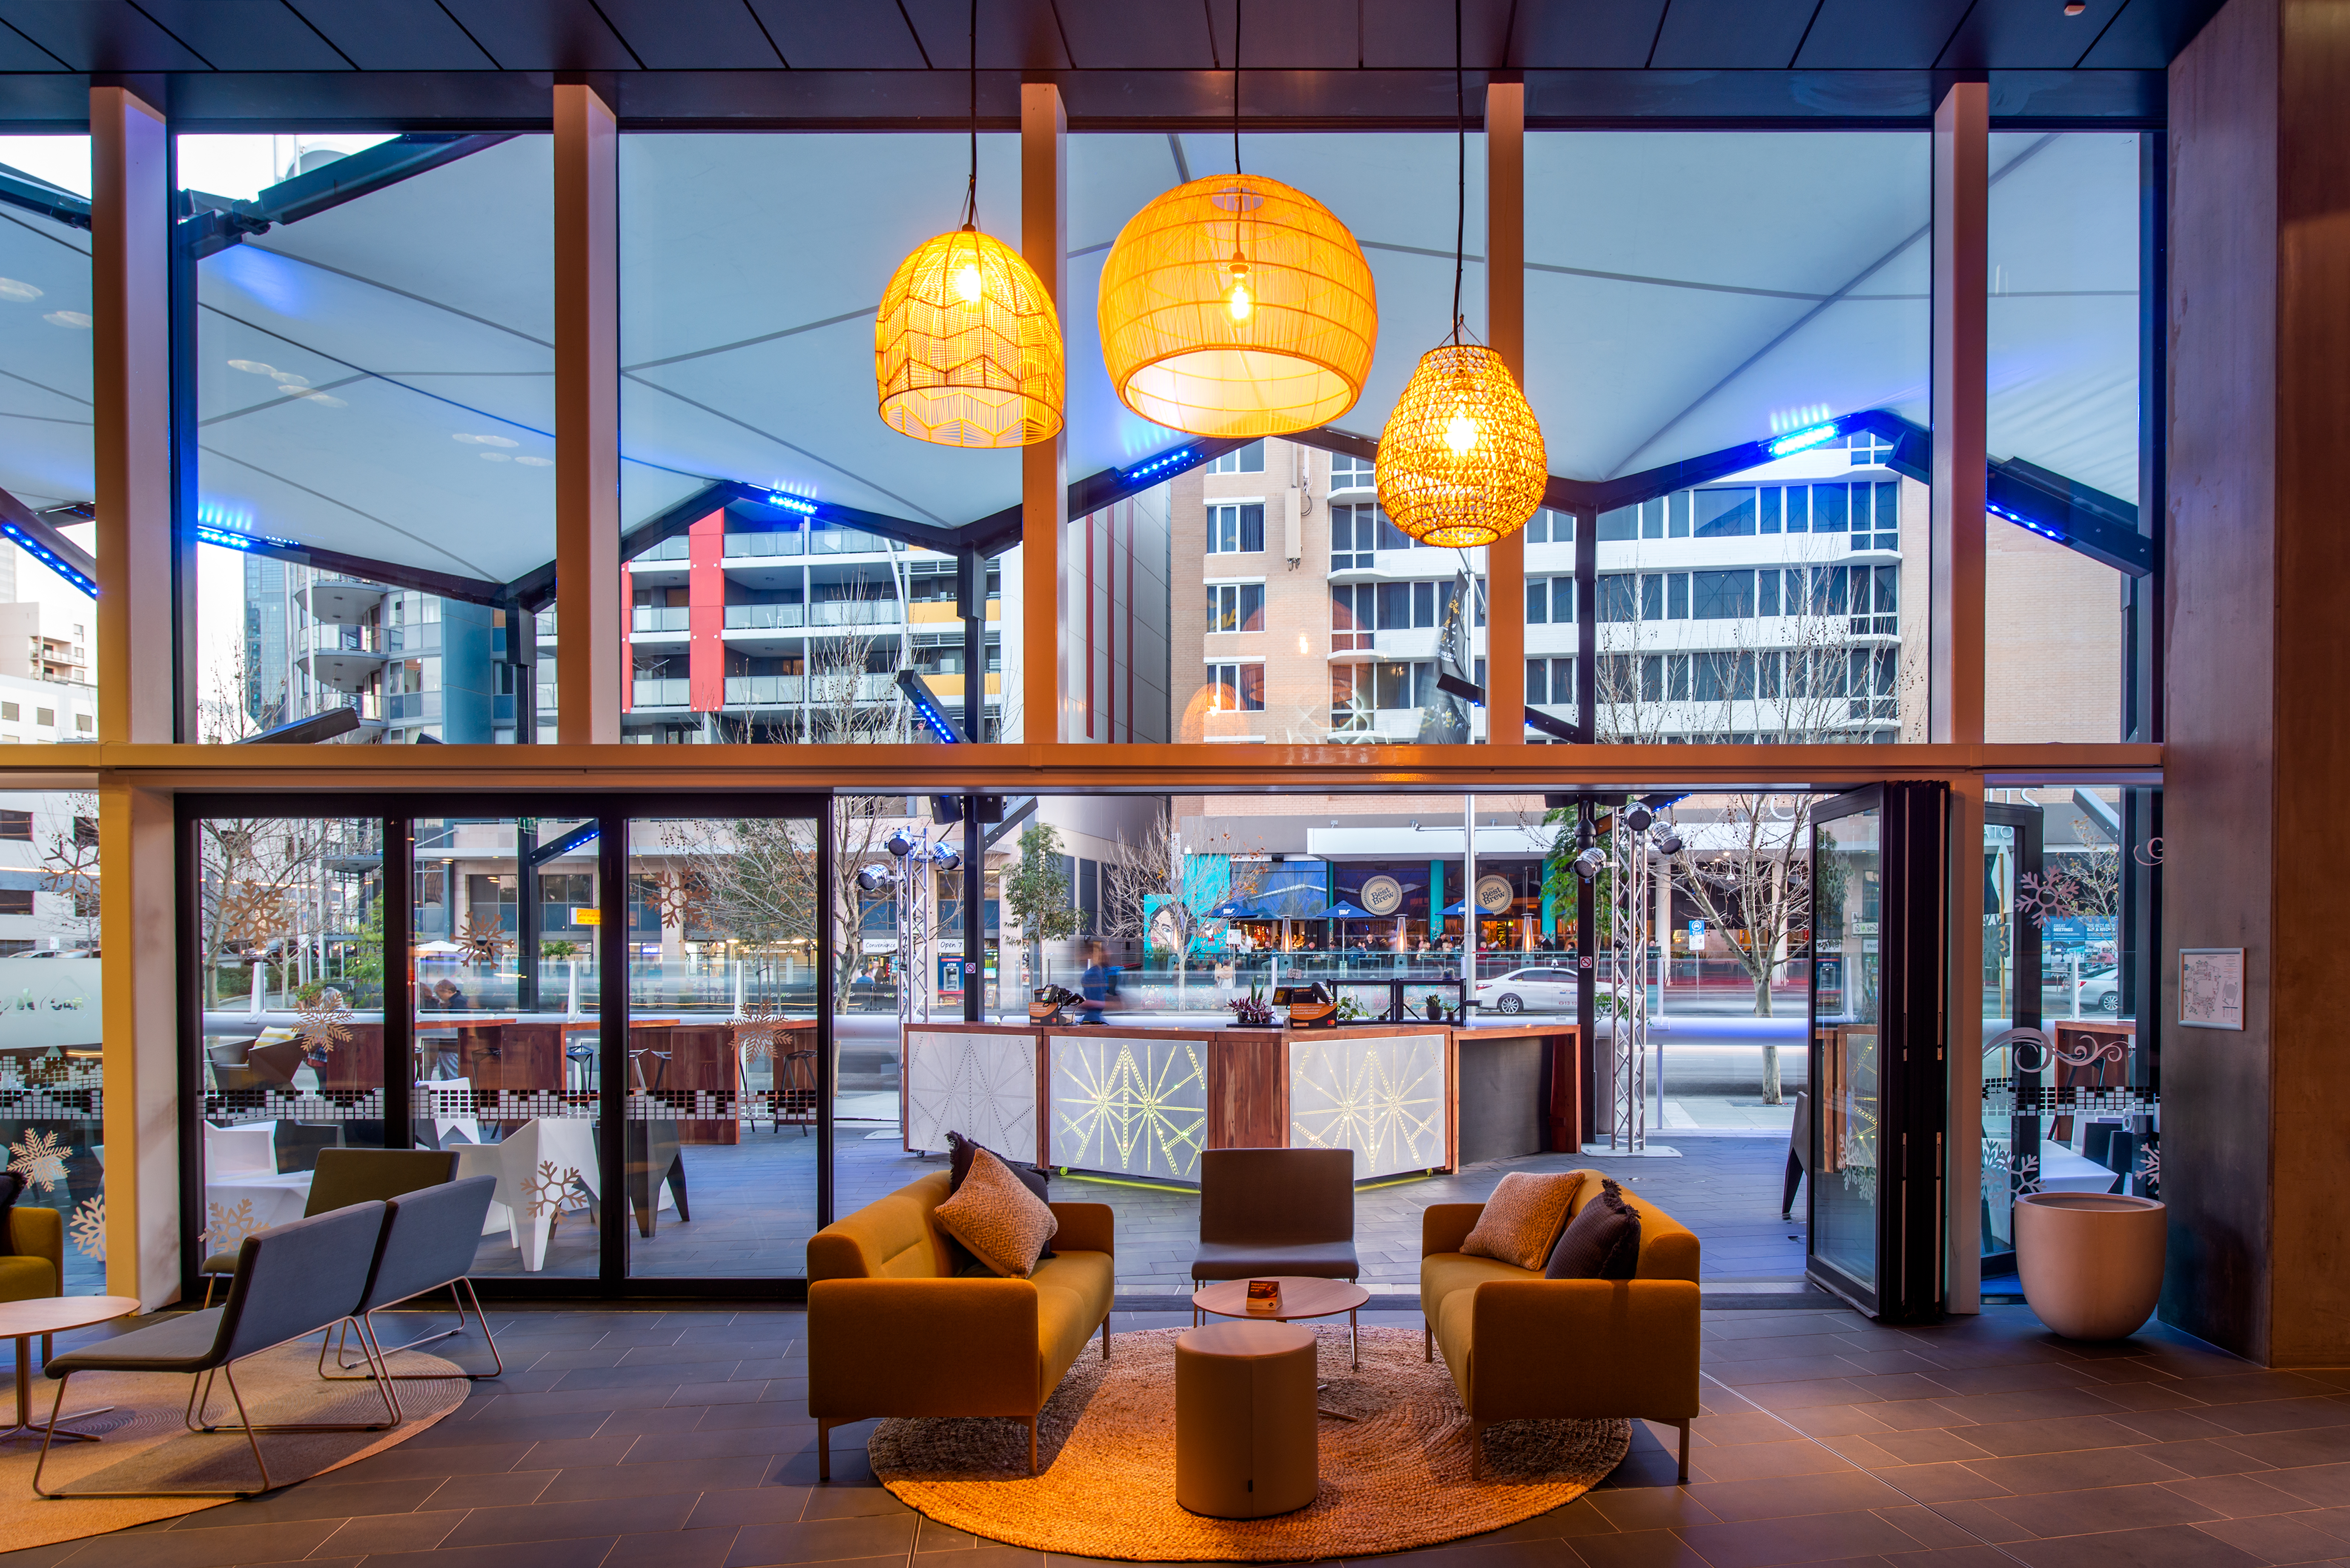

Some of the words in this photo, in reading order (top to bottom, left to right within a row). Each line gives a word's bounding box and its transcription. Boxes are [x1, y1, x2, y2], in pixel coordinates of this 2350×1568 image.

[1370, 887, 1390, 898] Best
[1481, 886, 1502, 898] Best
[1482, 891, 1505, 905] Brew
[1371, 892, 1394, 905] Brew
[940, 941, 956, 950] Open
